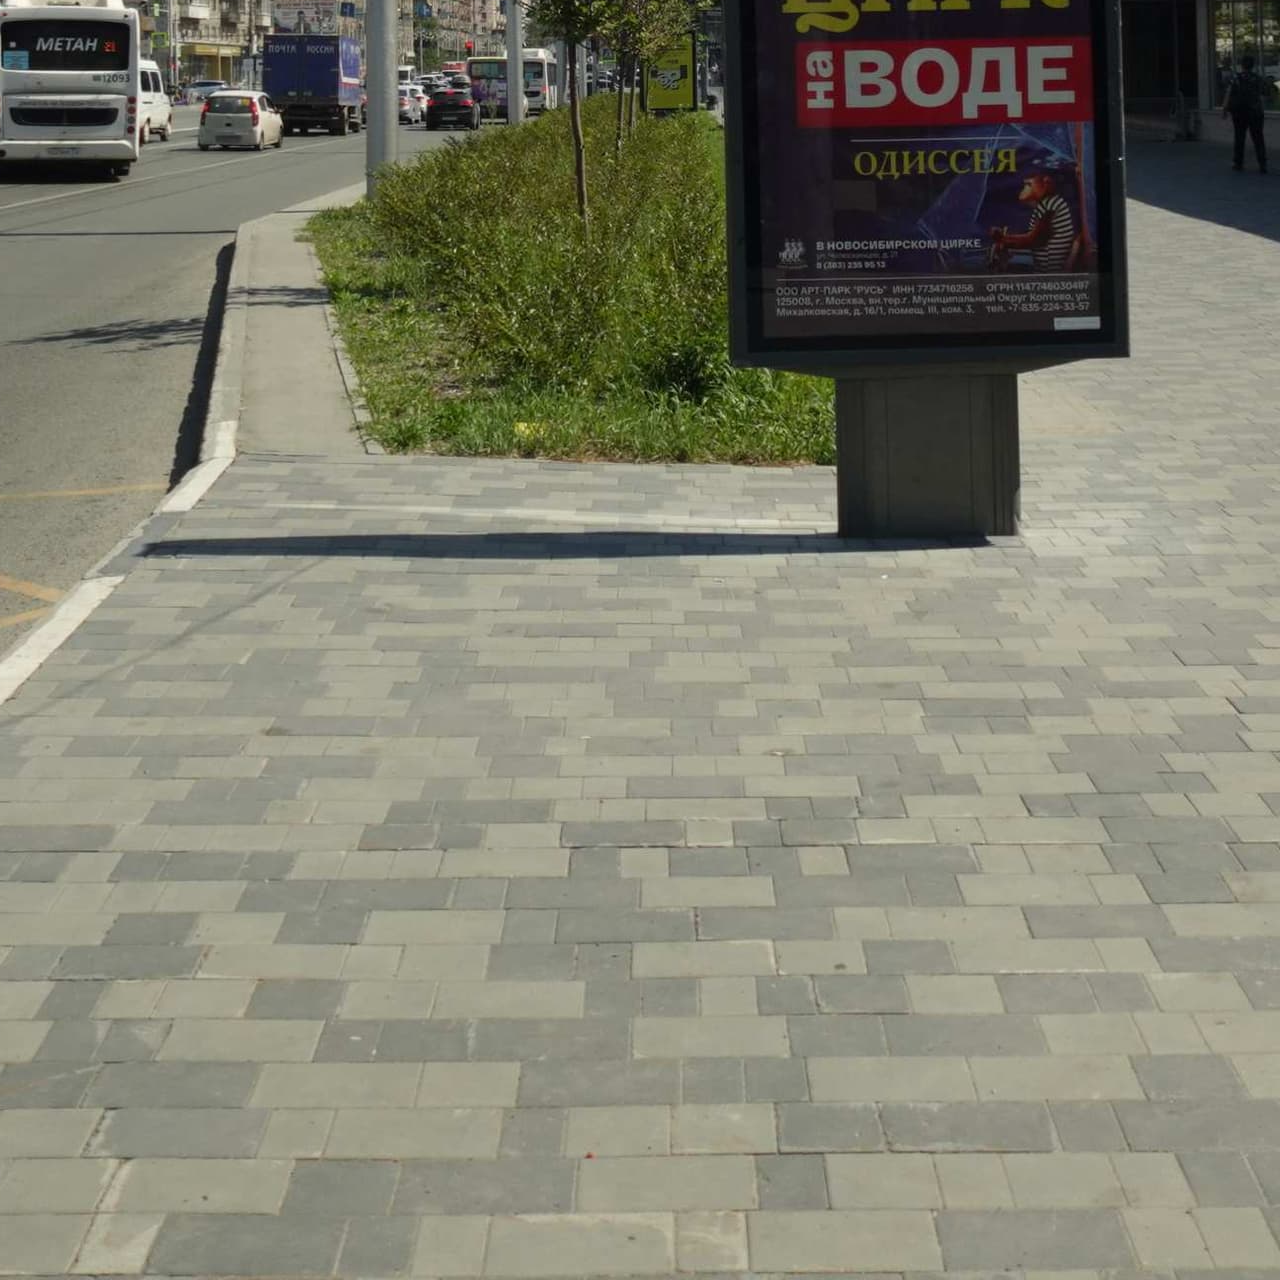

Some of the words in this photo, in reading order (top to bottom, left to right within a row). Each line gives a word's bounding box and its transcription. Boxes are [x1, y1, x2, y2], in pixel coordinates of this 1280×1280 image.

[36, 37, 98, 52] МЕТАН
[268, 44, 297, 54] ПОЧТА
[103, 74, 130, 83] 12093
[806, 50, 835, 109] на
[844, 45, 1076, 119] ВОДЕ
[853, 148, 1018, 180] ОДИССЕЯ
[816, 241, 824, 251] В
[827, 240, 938, 251] НОВОСИБИРСКОМ
[940, 239, 981, 250] ЦИРКЕ
[776, 286, 798, 296] ООО
[800, 285, 852, 295] АРТ-ПАРК
[853, 285, 887, 295] "РУСЬ"
[892, 284, 914, 293] ИНН
[986, 283, 1014, 292] ОГРН
[825, 296, 866, 306] Москва,
[912, 294, 995, 306] Муниципальный
[997, 293, 1028, 304] Округ
